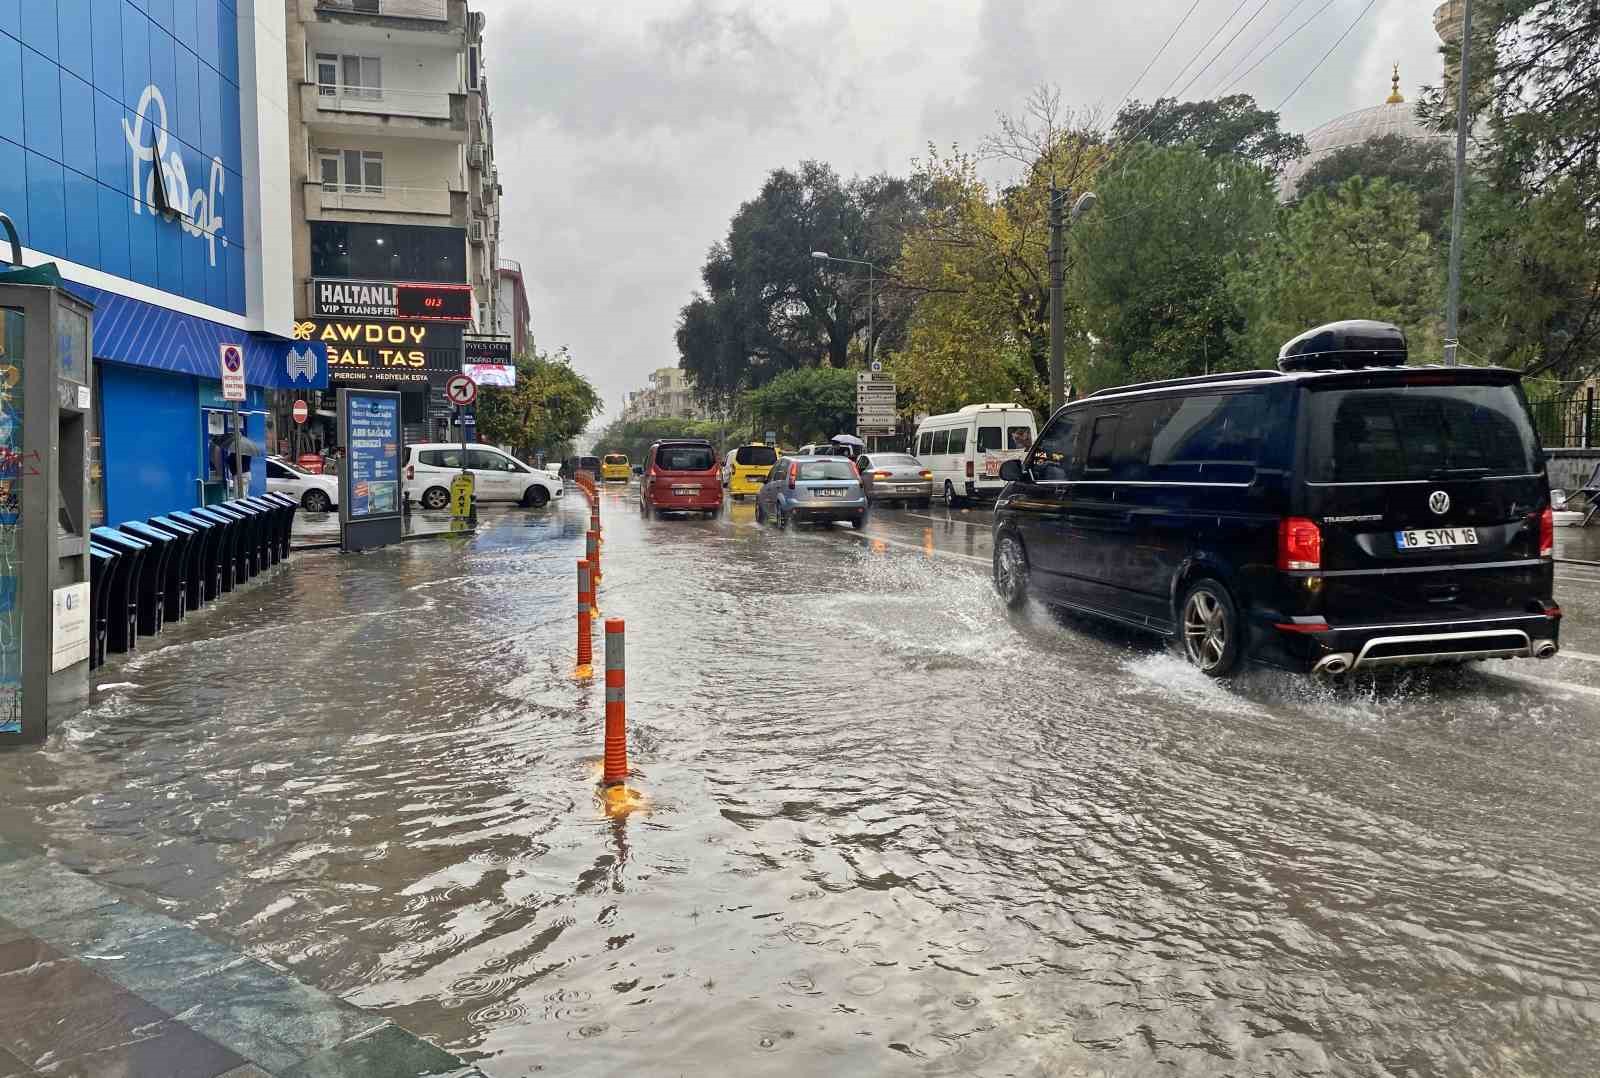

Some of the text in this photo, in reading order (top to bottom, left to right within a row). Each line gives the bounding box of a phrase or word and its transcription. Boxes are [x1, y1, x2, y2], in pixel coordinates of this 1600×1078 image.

[321, 284, 397, 306] HALTANLI
[321, 304, 396, 316] VIP TRANSFER
[319, 322, 426, 344] AWDOY
[378, 350, 424, 369] TAŞ
[1404, 528, 1475, 547] 16 SYN 16
